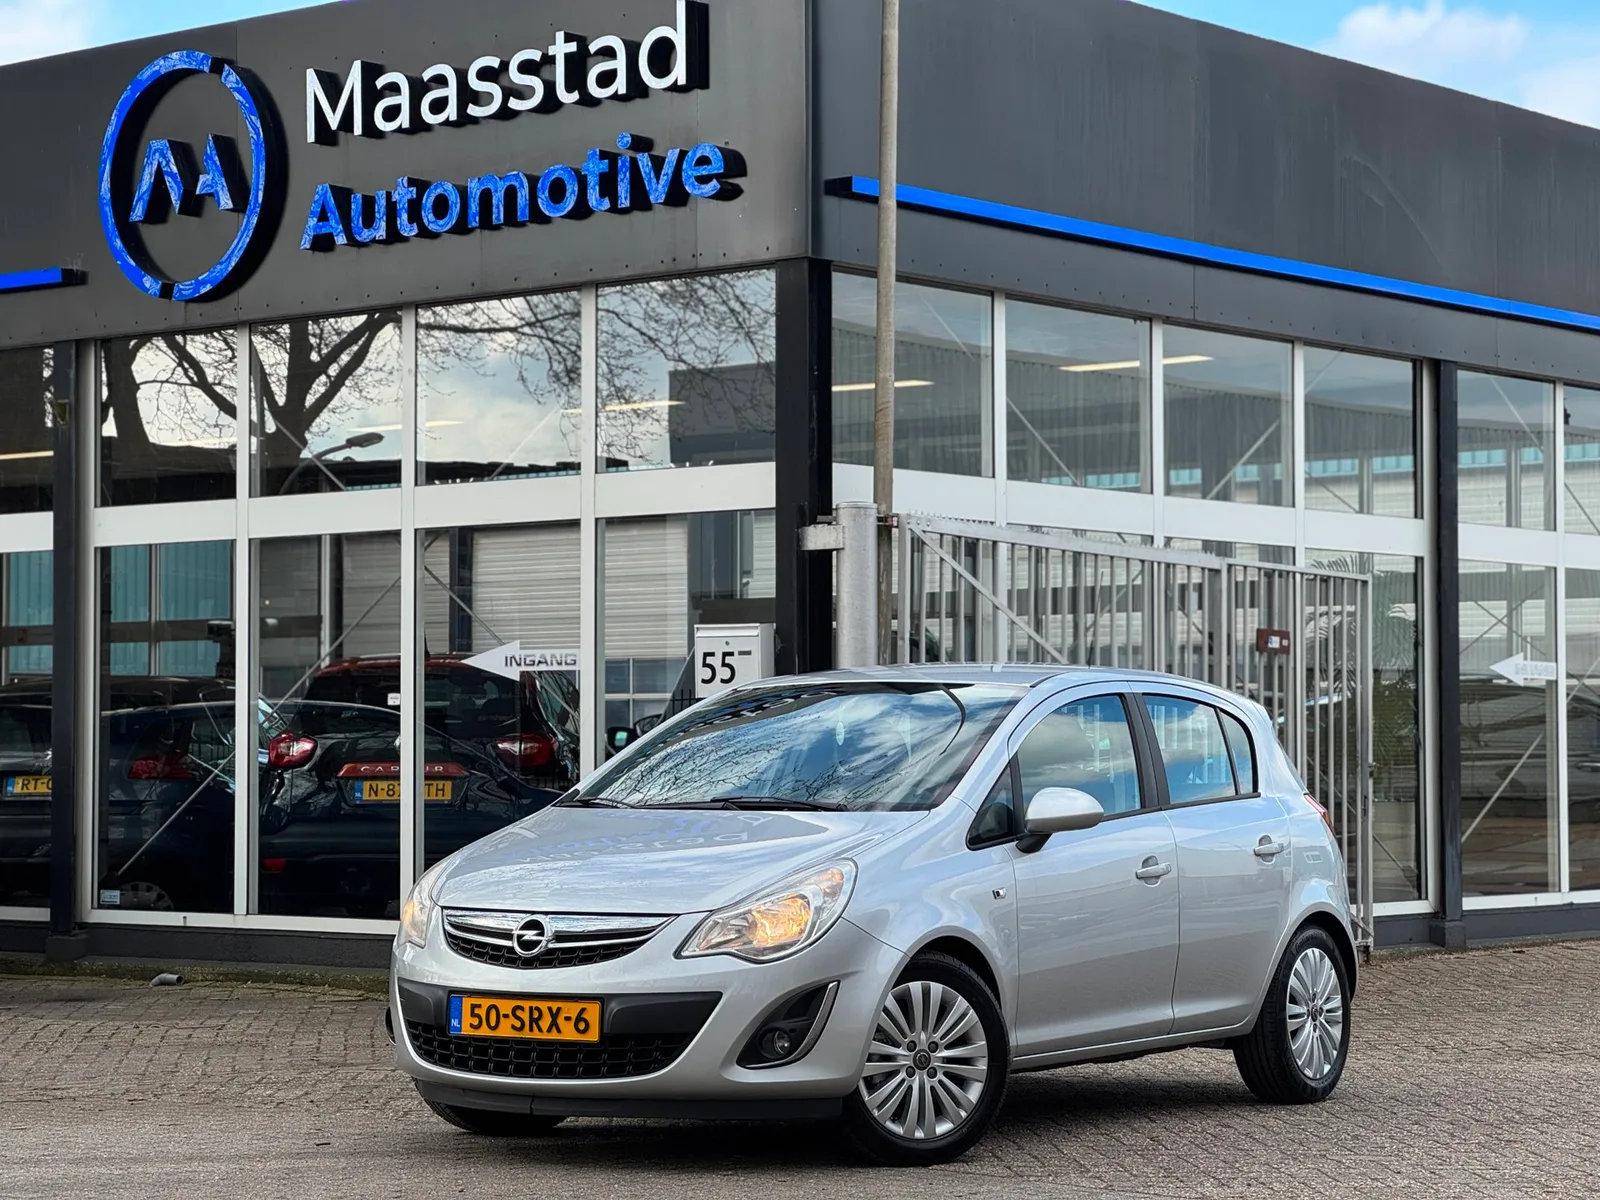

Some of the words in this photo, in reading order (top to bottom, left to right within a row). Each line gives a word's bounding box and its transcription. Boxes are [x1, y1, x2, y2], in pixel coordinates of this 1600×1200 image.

[305, 0, 690, 143] Maasstad
[299, 132, 725, 251] Automotive
[504, 653, 578, 667] INGANG
[701, 651, 736, 684] 55
[368, 783, 445, 797] N-8TH
[451, 1019, 461, 1027] NL
[469, 1003, 590, 1034] 50-SRX-6
